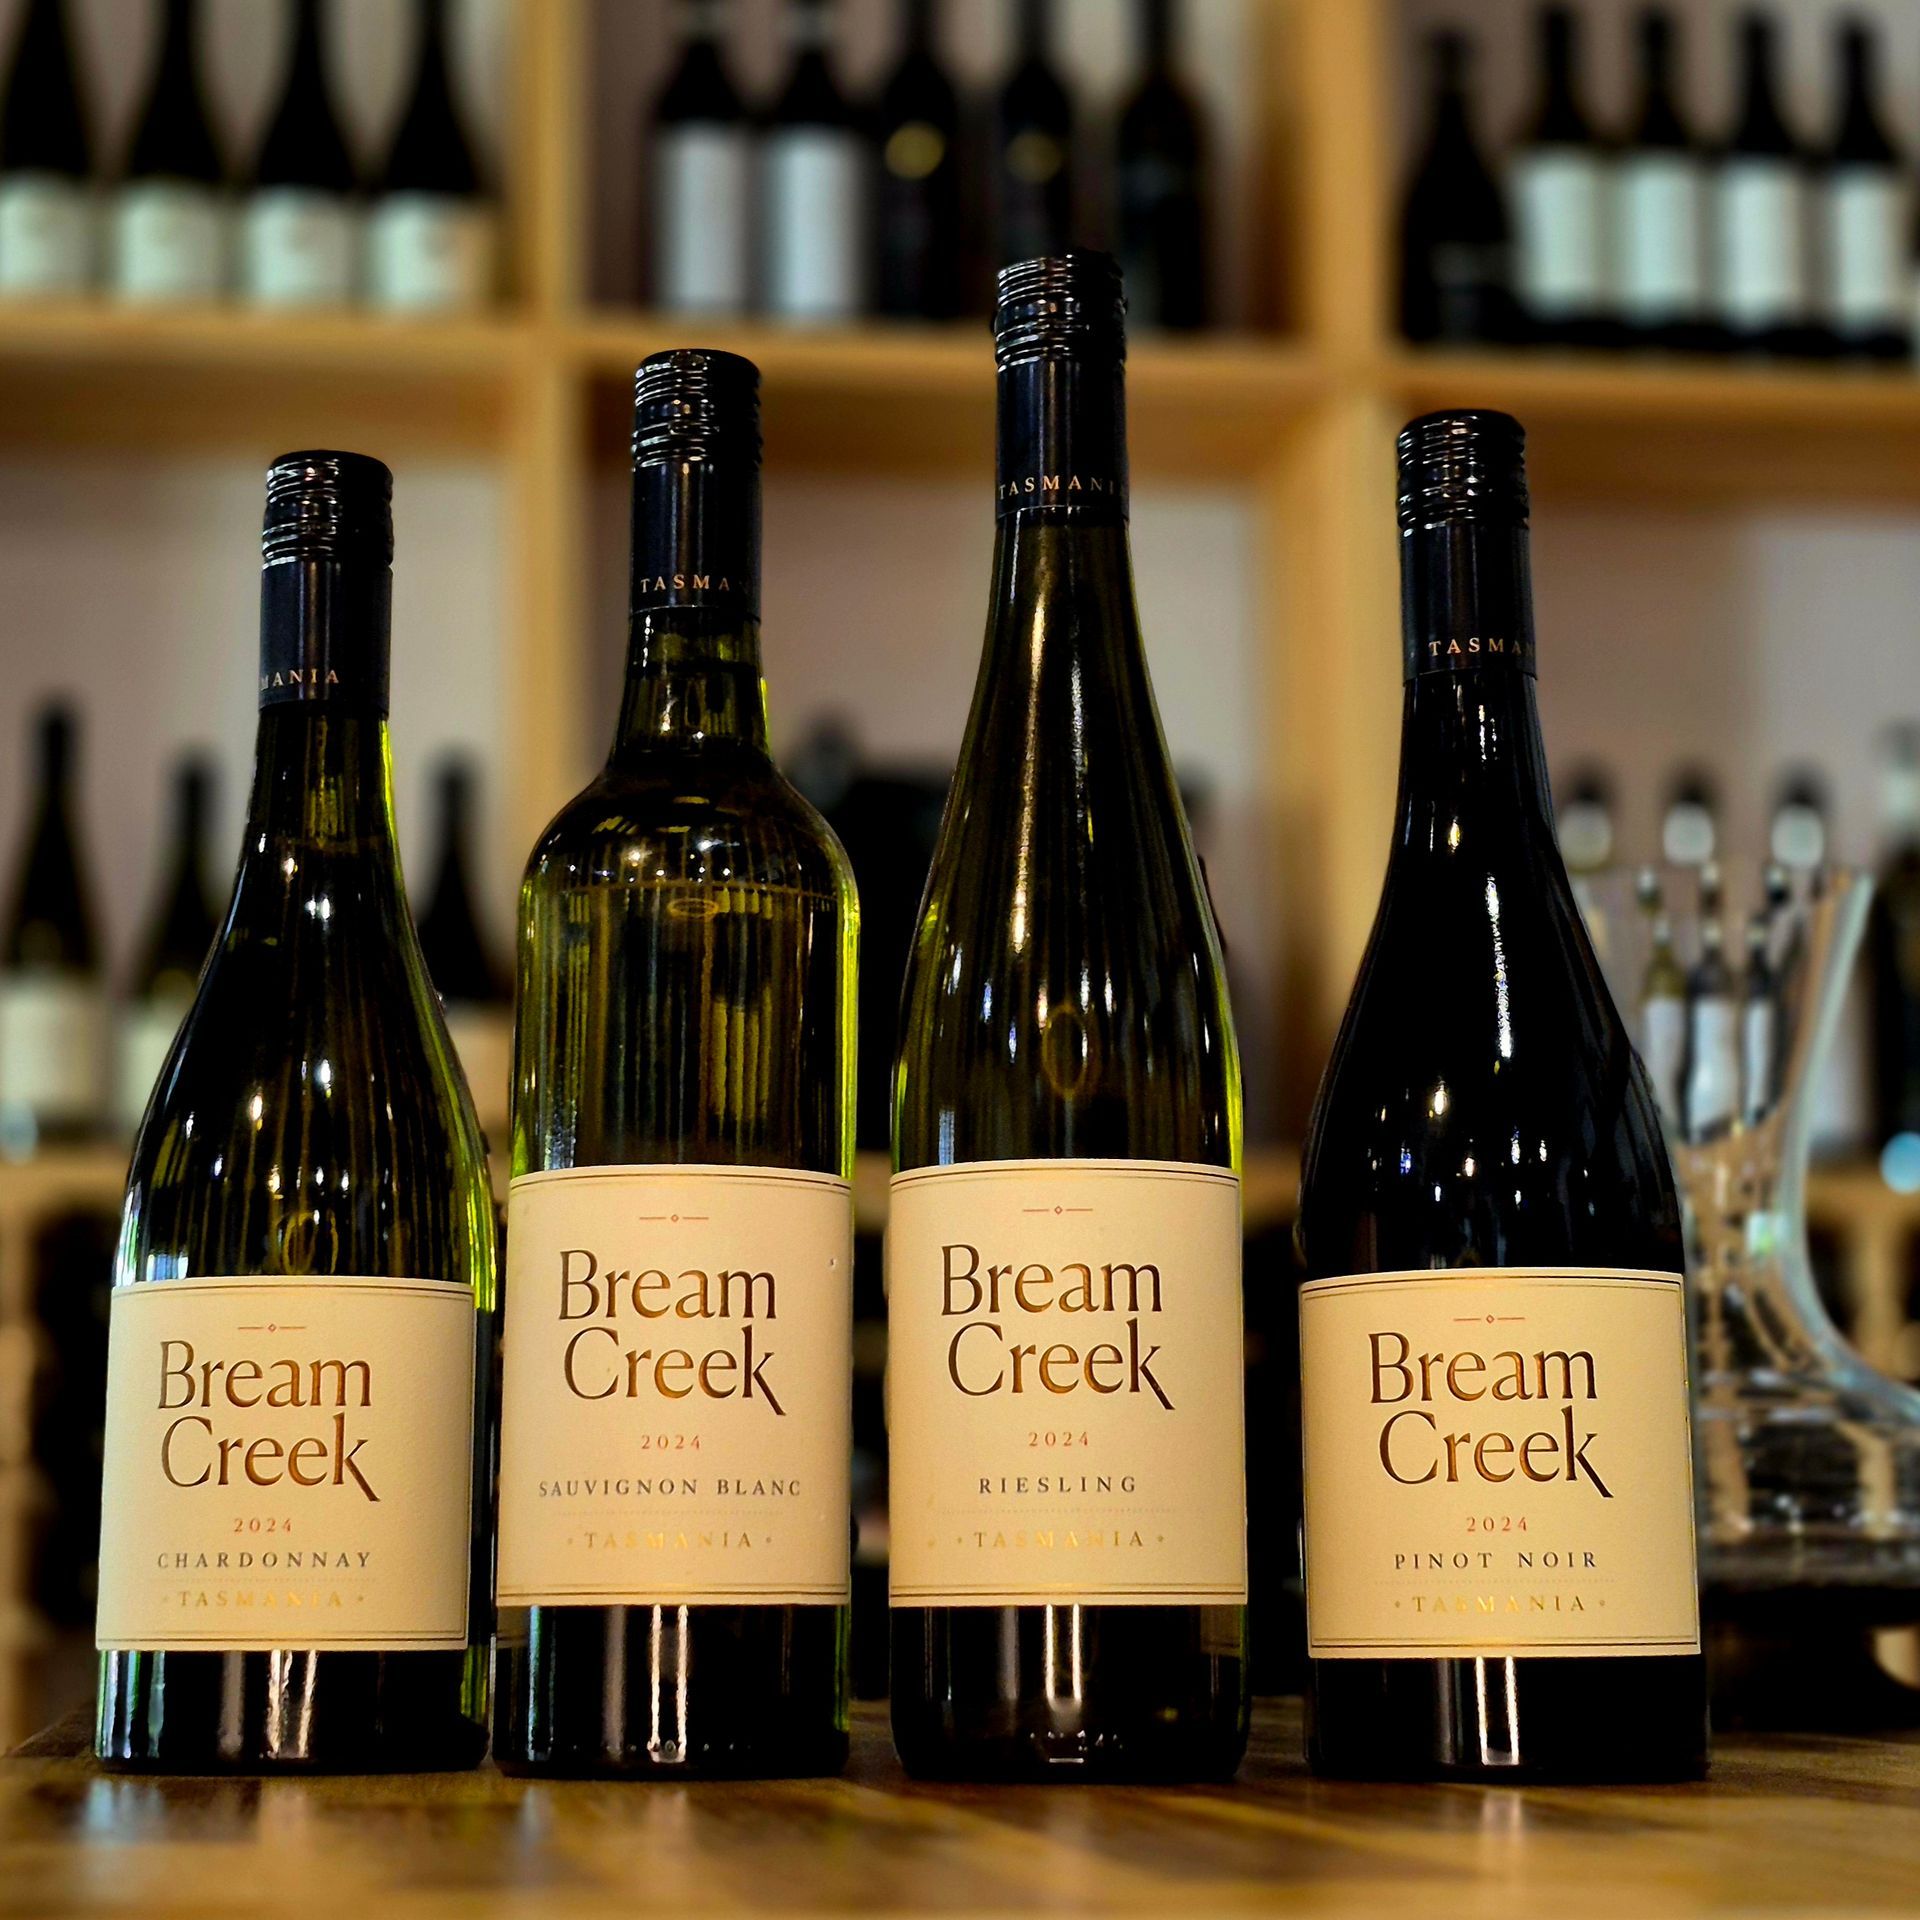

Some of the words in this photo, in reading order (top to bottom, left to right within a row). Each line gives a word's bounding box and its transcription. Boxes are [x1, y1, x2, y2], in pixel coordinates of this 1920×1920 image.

[559, 1249, 776, 1320] Bream
[941, 1244, 1162, 1316] Bream
[564, 1324, 786, 1416] Creek
[948, 1317, 1176, 1410] Creek
[1368, 1331, 1597, 1404] Bream
[158, 1340, 372, 1409] Bream
[641, 1434, 701, 1451] 2024
[1028, 1431, 1091, 1448] 2024
[161, 1412, 381, 1502] Creek
[1379, 1405, 1614, 1498] Creek
[539, 1478, 698, 1498] SAUVIGNON
[716, 1478, 802, 1497] BLANC
[979, 1476, 1136, 1495] RIESLING
[233, 1517, 293, 1534] 2024
[1466, 1516, 1528, 1533] 2024
[584, 1531, 753, 1550] TASMANIA
[974, 1530, 1144, 1549] TASMANIA
[157, 1550, 372, 1569] CHARDONNAY
[1394, 1552, 1494, 1571] PINOT
[1518, 1551, 1597, 1569] NOIR
[177, 1590, 343, 1608] TASMANIA
[1412, 1595, 1586, 1613] TASMANIA
